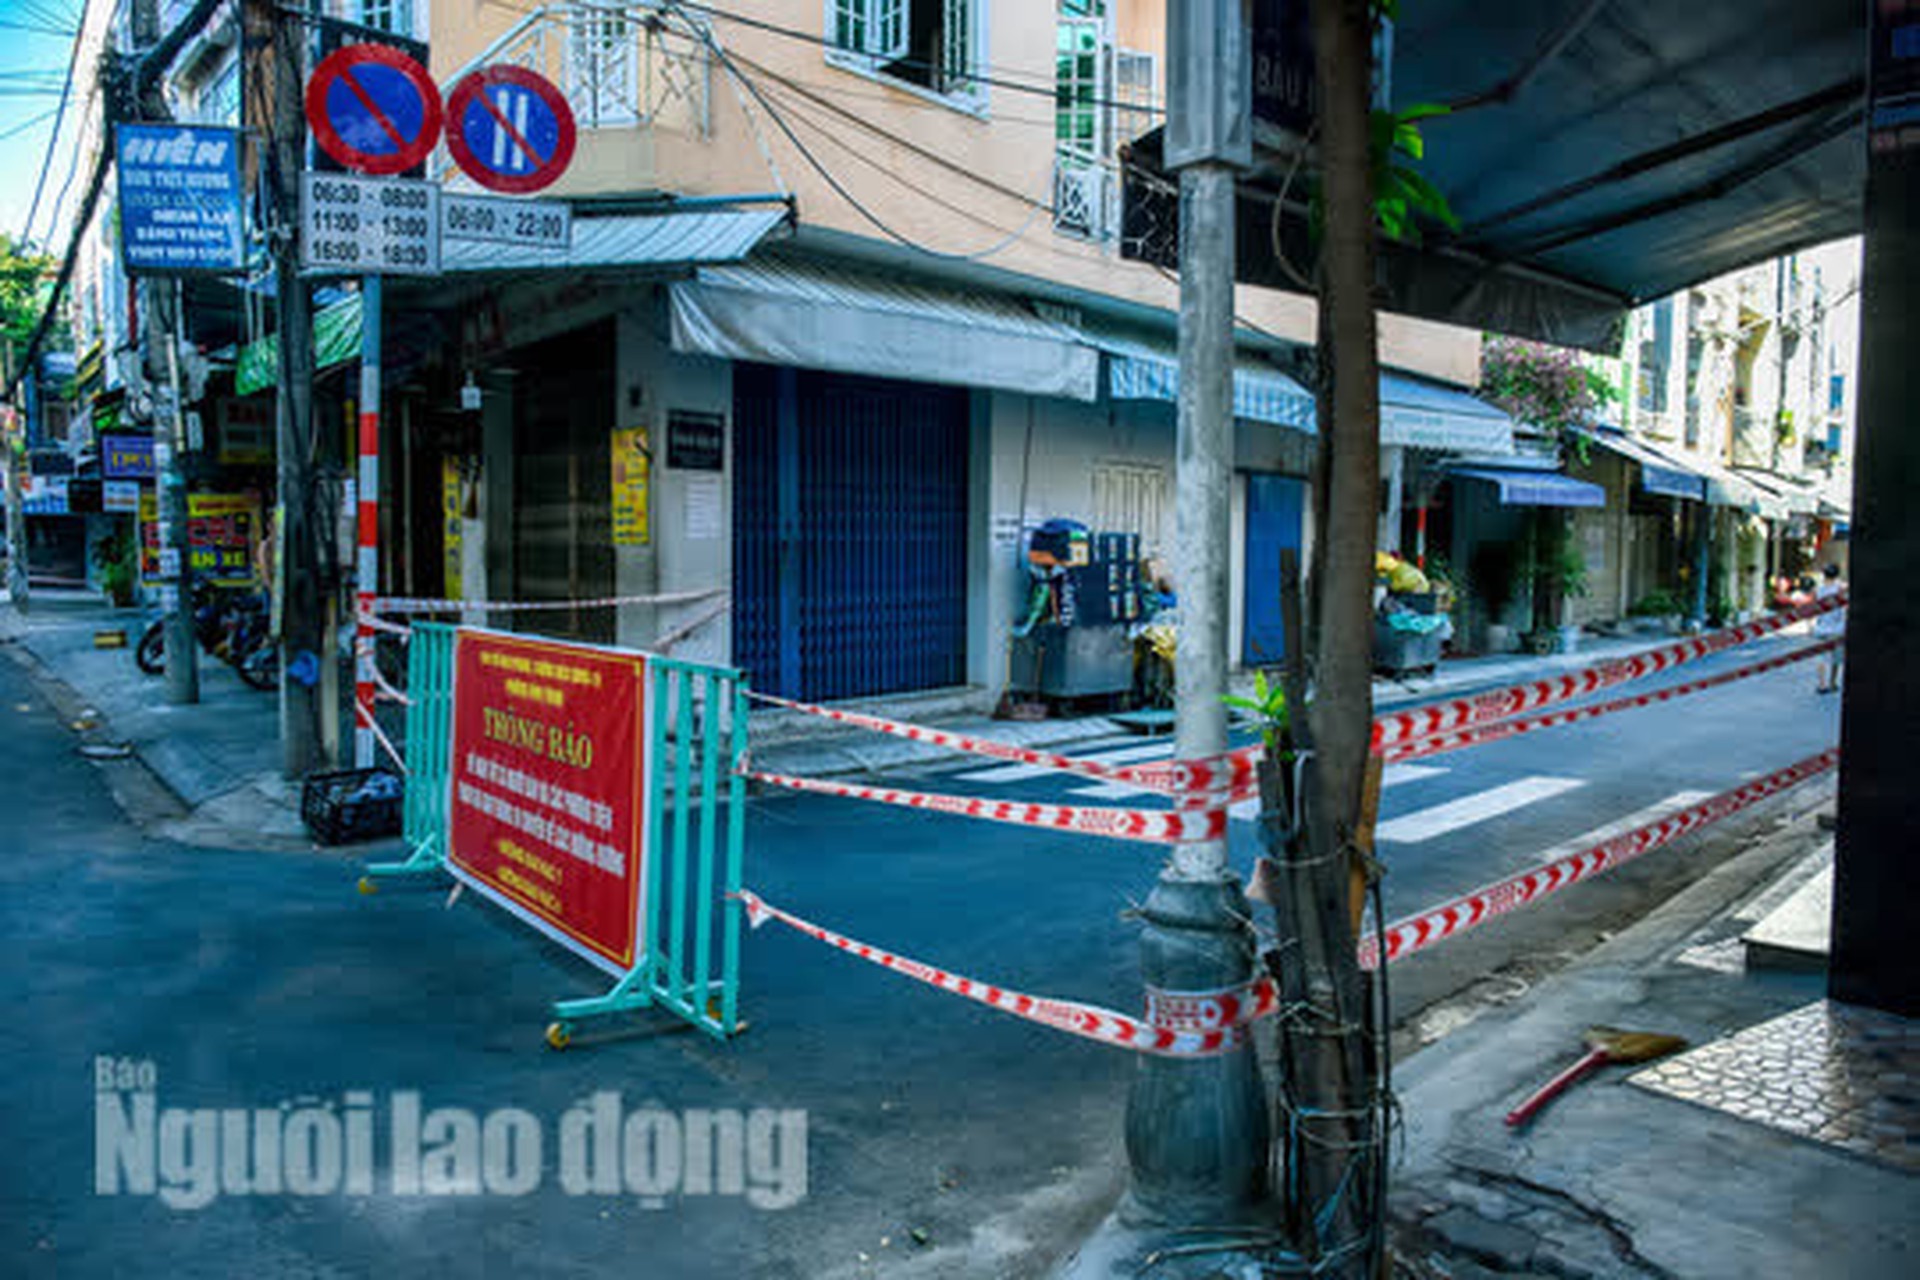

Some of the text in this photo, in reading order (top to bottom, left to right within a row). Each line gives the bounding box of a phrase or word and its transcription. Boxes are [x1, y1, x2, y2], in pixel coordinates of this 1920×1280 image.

[312, 181, 360, 204] 06:30
[312, 209, 360, 232] 11:00
[382, 215, 428, 237] 13:00
[515, 211, 562, 239] 22:00
[483, 704, 593, 769] THÔNG BÁO
